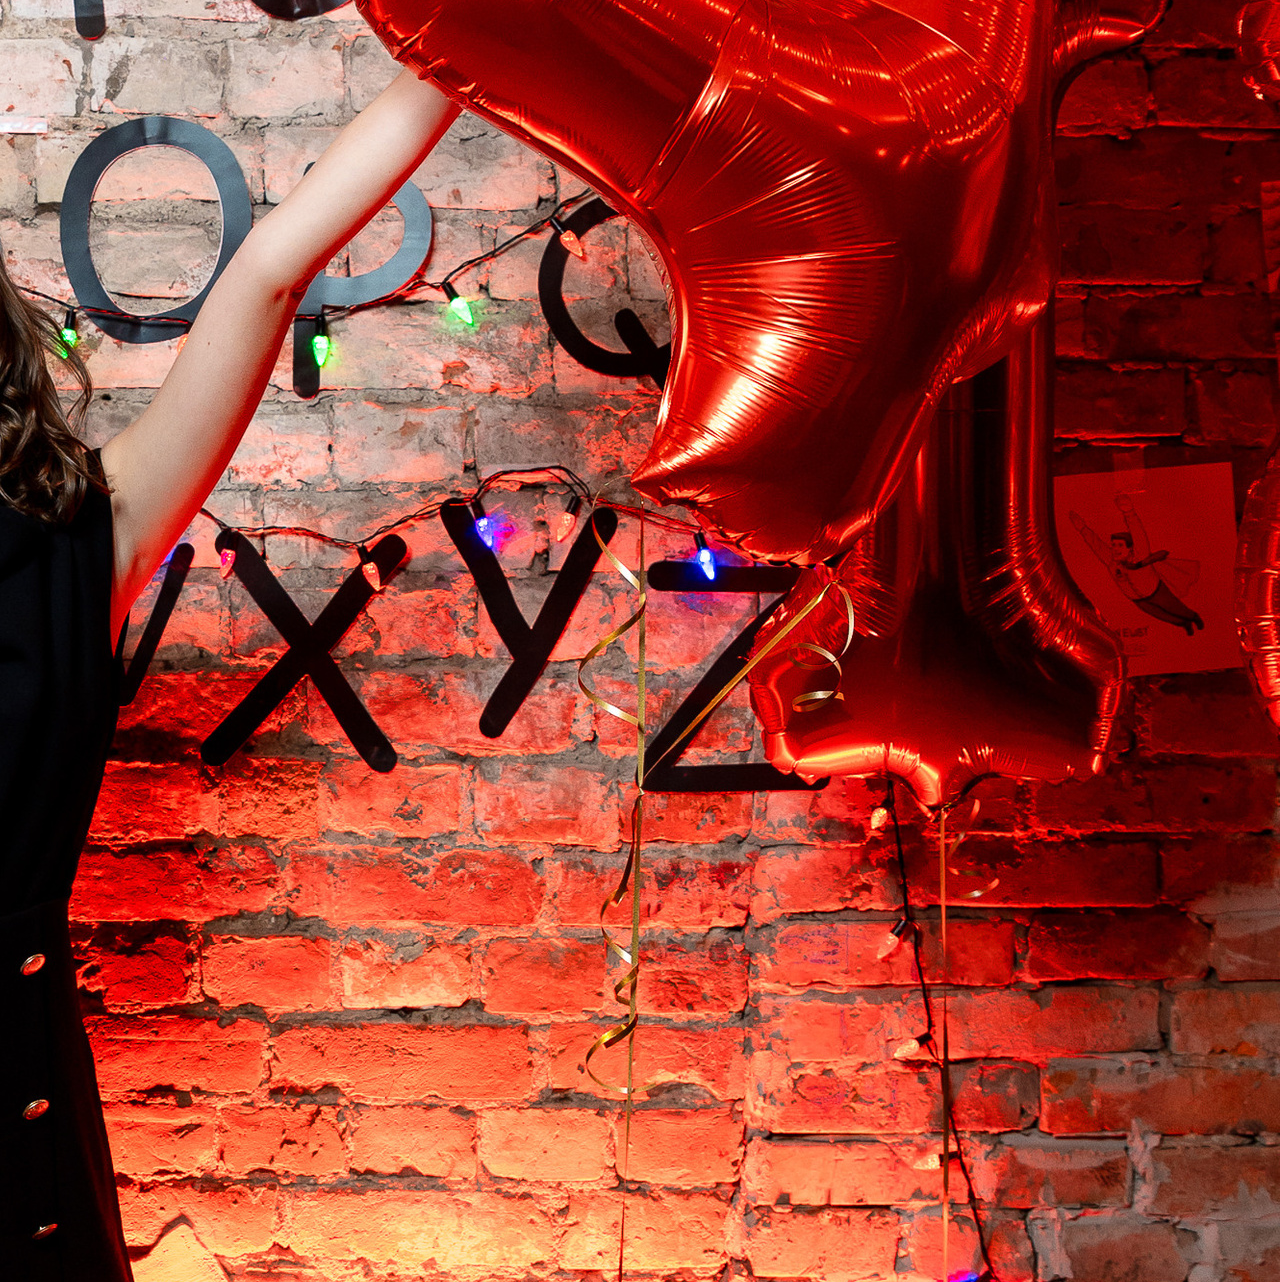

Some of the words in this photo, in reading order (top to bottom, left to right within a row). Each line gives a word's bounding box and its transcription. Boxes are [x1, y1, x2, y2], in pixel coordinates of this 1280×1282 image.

[60, 116, 254, 345] O
[199, 527, 409, 774] X
[439, 497, 619, 739] Y
[640, 560, 830, 793] Z
